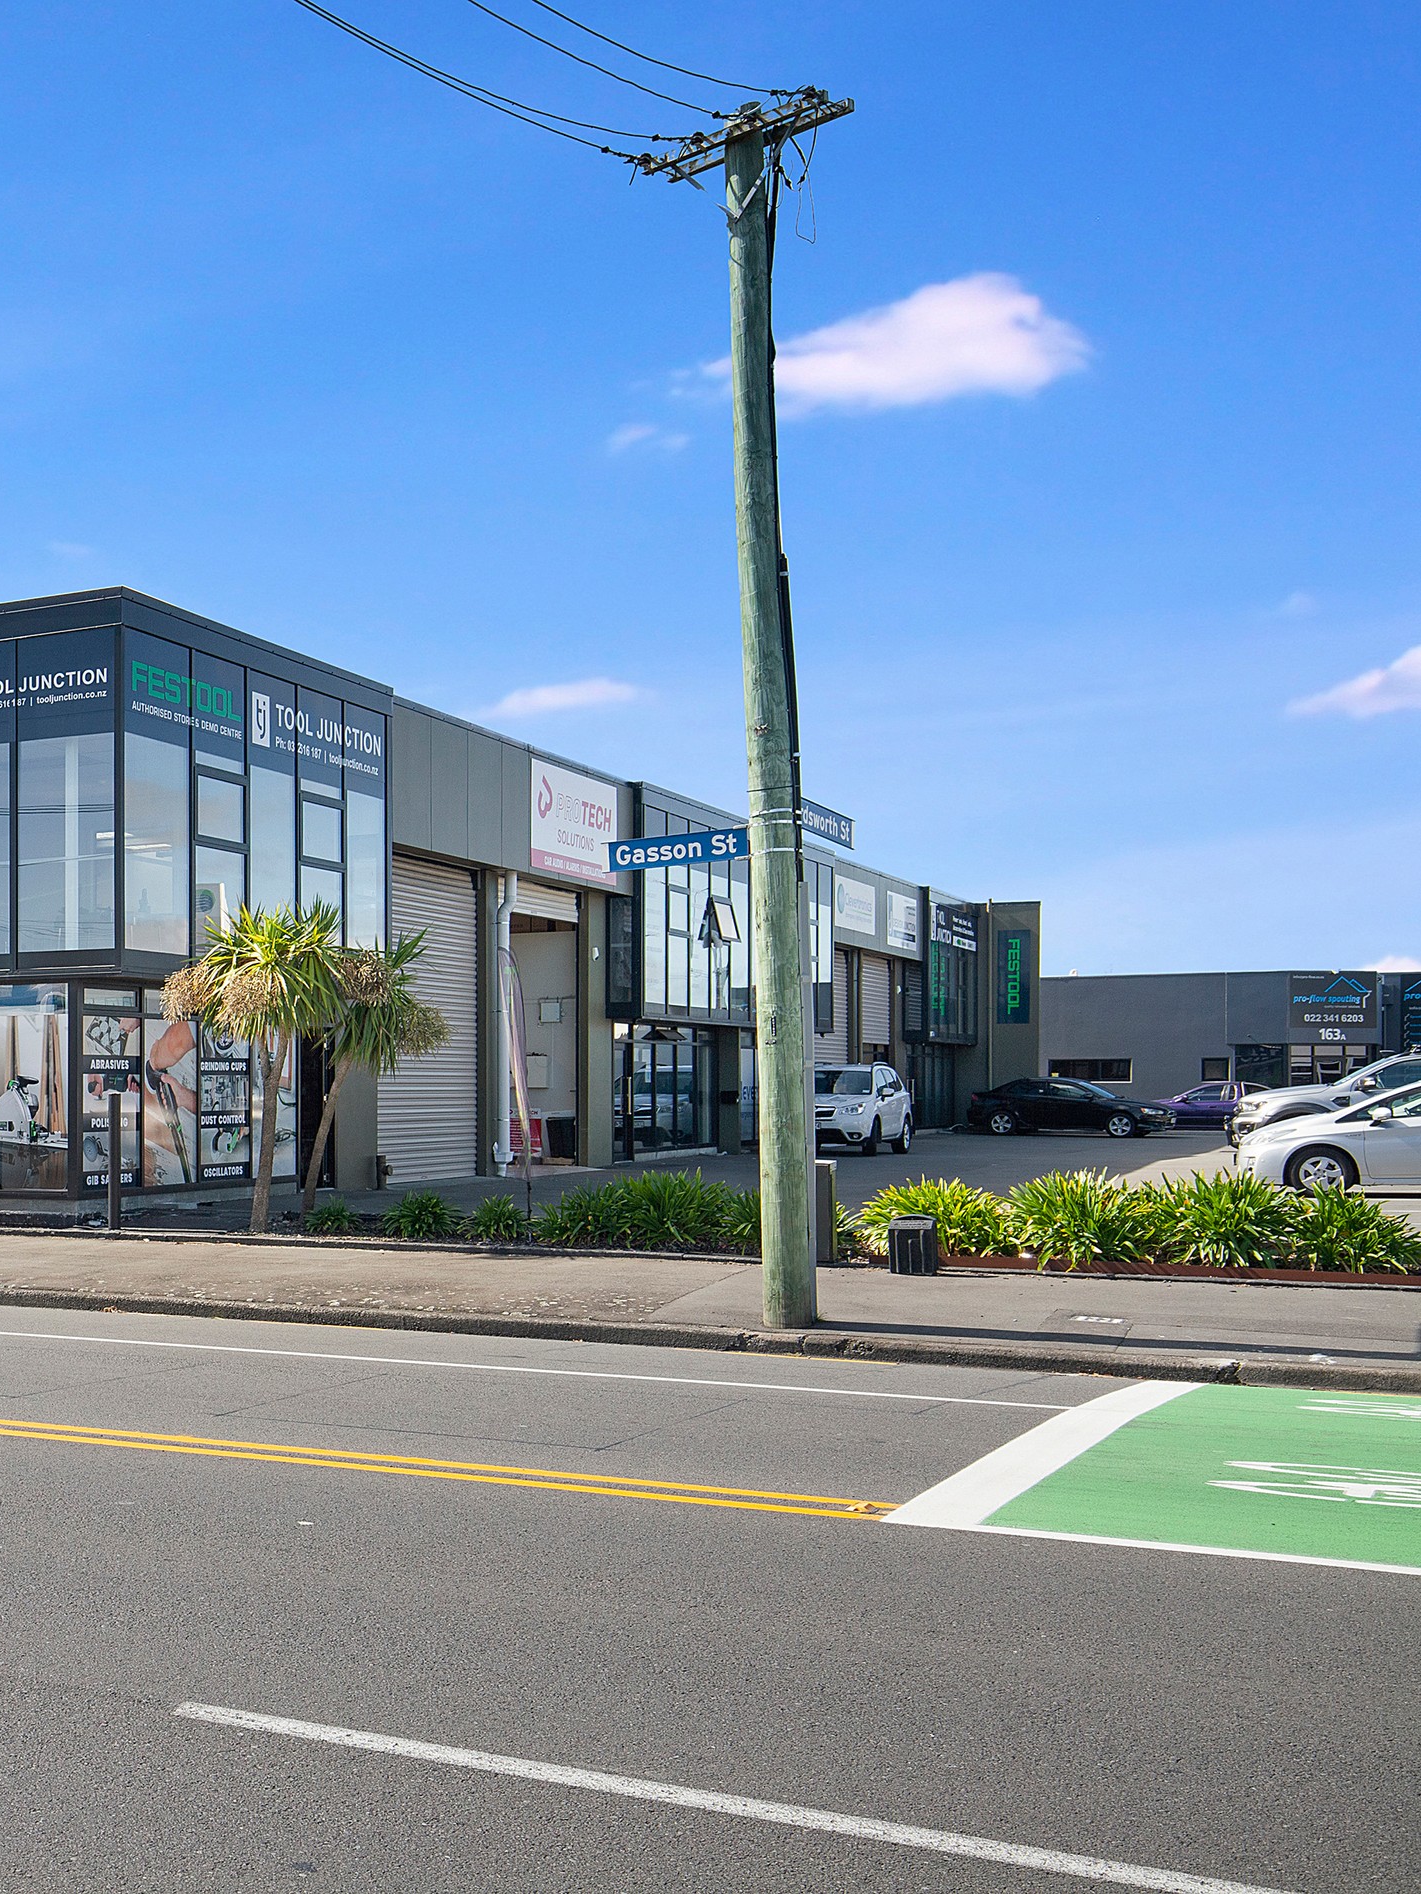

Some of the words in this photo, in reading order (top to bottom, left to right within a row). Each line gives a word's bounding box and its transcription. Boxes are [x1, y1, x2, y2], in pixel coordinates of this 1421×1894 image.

[18, 668, 108, 692] JUNCTION
[36, 690, 107, 704] tooljunction.co.nz
[132, 660, 241, 722] FESTOOL
[132, 700, 172, 720] AUTHORISED
[174, 712, 194, 726] STORE
[201, 720, 218, 732] DEMO
[220, 726, 242, 740] CENTRE
[276, 704, 314, 736] TOOL
[316, 718, 381, 756] JUNCTION
[287, 740, 295, 752] 03
[311, 746, 322, 760] 187
[556, 792, 612, 832] PROTECH
[801, 808, 838, 837] dsworth
[840, 826, 850, 842] St
[557, 829, 595, 852] SOLUTIONS
[615, 841, 702, 866] Gasson
[711, 833, 738, 856] St
[1008, 938, 1020, 1015] FESTOOL
[1293, 994, 1326, 1004] pro-flow
[1328, 995, 1361, 1004] spouting
[1304, 1014, 1322, 1022] 022
[1323, 1014, 1339, 1022] 341
[1341, 1014, 1364, 1022] 6203
[1319, 1028, 1346, 1040] 163A
[90, 1059, 130, 1070] ABRASIVES
[200, 1062, 230, 1071] GRINDING
[230, 1062, 247, 1071] CUPS
[91, 1118, 128, 1128] POLISG
[201, 1116, 217, 1125] DUST
[218, 1114, 246, 1124] CONTROL
[86, 1176, 99, 1186] GIB
[100, 1173, 133, 1184] SAERS
[204, 1166, 243, 1177] OSCILLATORS
